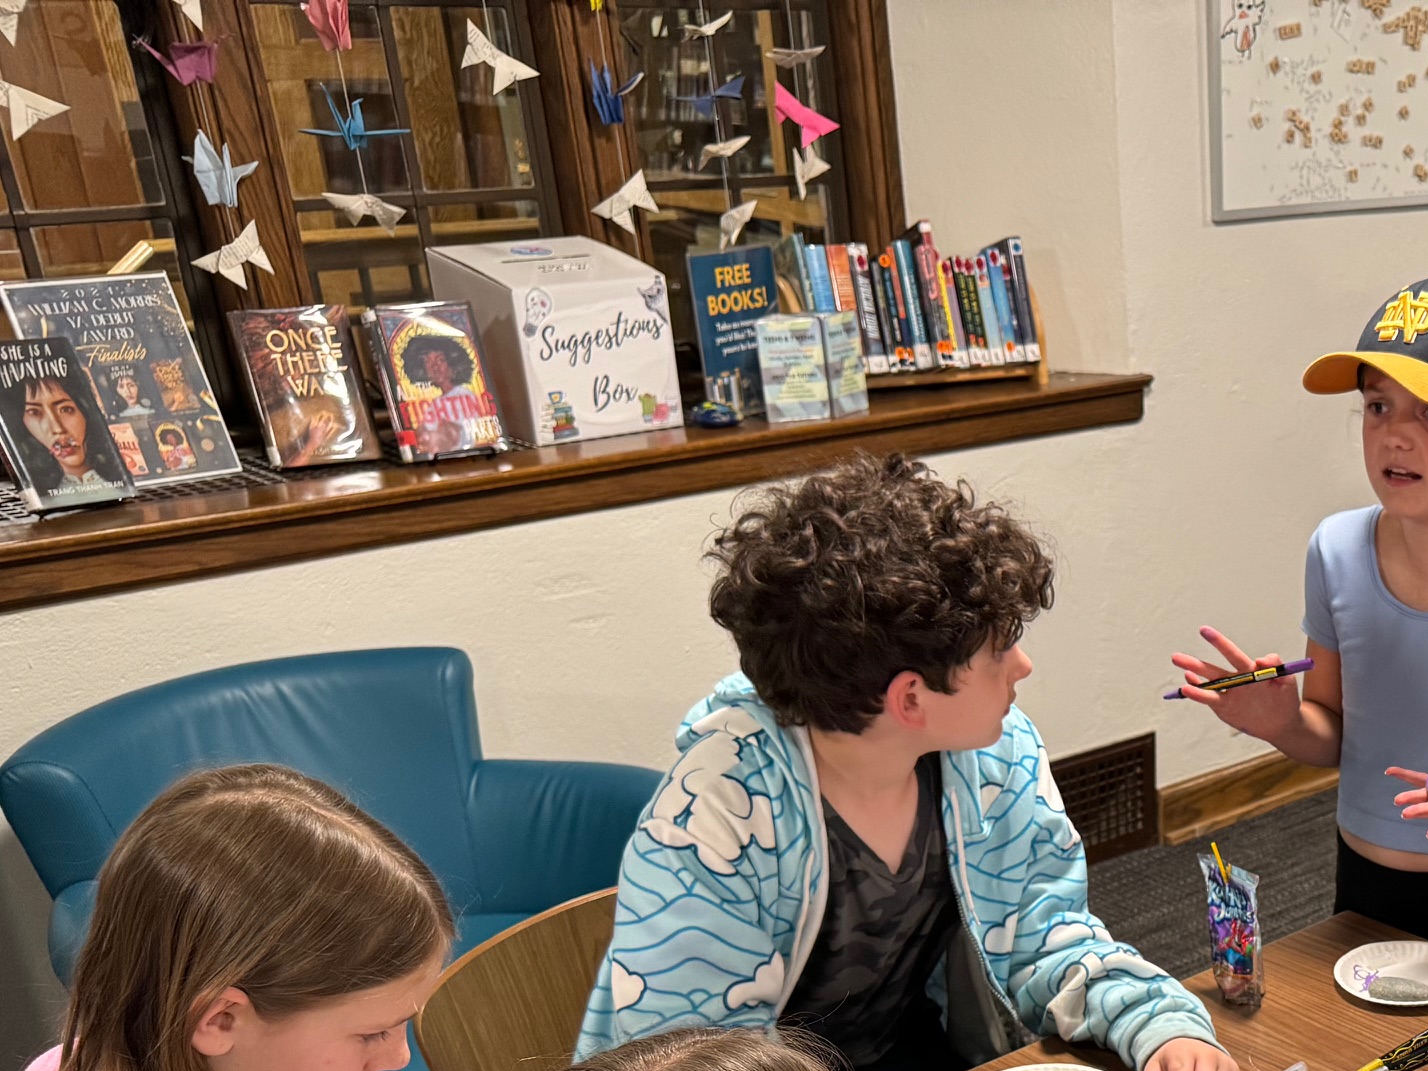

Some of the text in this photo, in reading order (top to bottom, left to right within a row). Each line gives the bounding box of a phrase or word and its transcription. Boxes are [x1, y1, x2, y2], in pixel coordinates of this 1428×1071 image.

[714, 263, 752, 288] FREE
[28, 301, 89, 317] WILLIAM
[110, 294, 162, 310] MORRIS
[706, 286, 768, 317] BOOKS!
[91, 311, 135, 327] DEBUT
[83, 328, 136, 344] AWARD
[265, 326, 343, 352] ONCE
[540, 311, 665, 368] Suggestions
[0, 343, 53, 361] SHE IS A
[78, 342, 147, 367] Finalists
[0, 357, 68, 389] HAUNTING
[593, 374, 640, 413] Box
[399, 391, 498, 430] FIGHTING
[461, 414, 503, 444] PARTS
[47, 486, 76, 498] TRANG
[103, 480, 125, 490] TRAN
